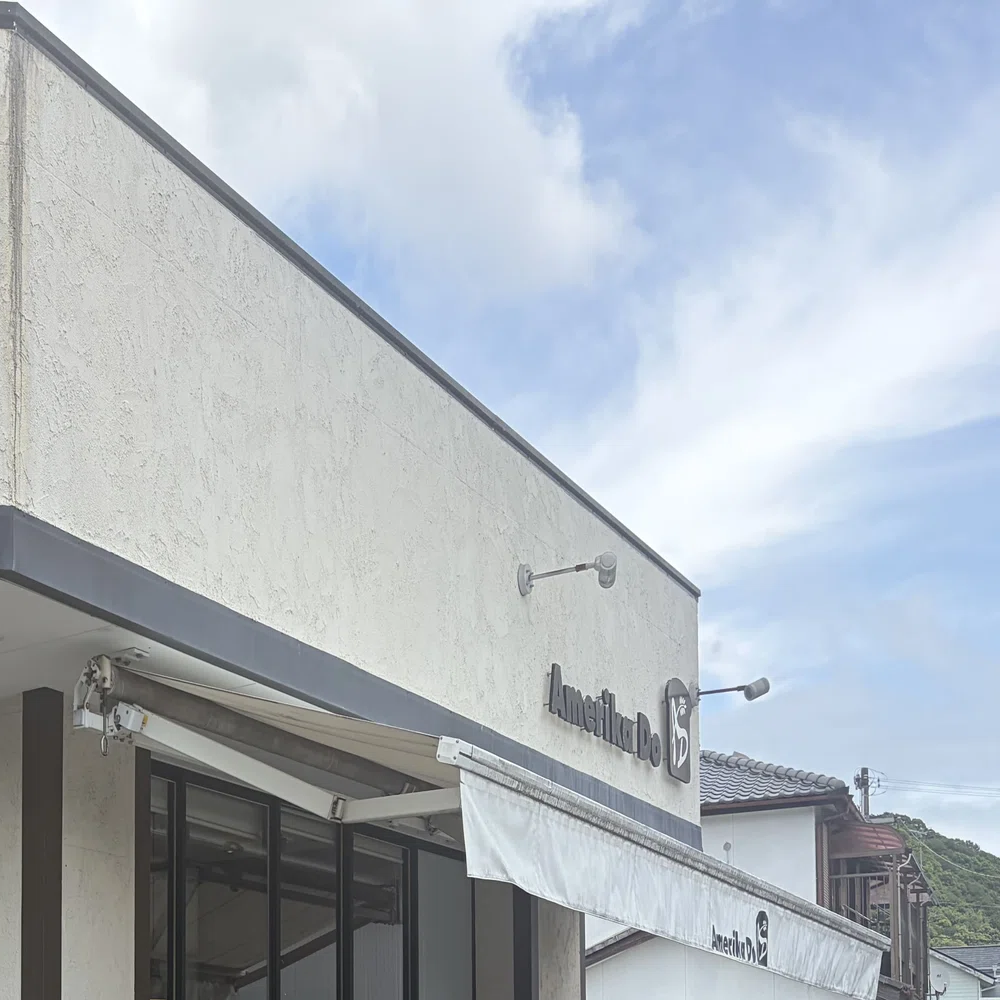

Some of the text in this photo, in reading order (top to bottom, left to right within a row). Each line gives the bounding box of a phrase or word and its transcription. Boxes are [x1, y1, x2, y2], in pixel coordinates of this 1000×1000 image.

[549, 663, 662, 768] Amerika Do
[711, 924, 746, 960] Amerika
